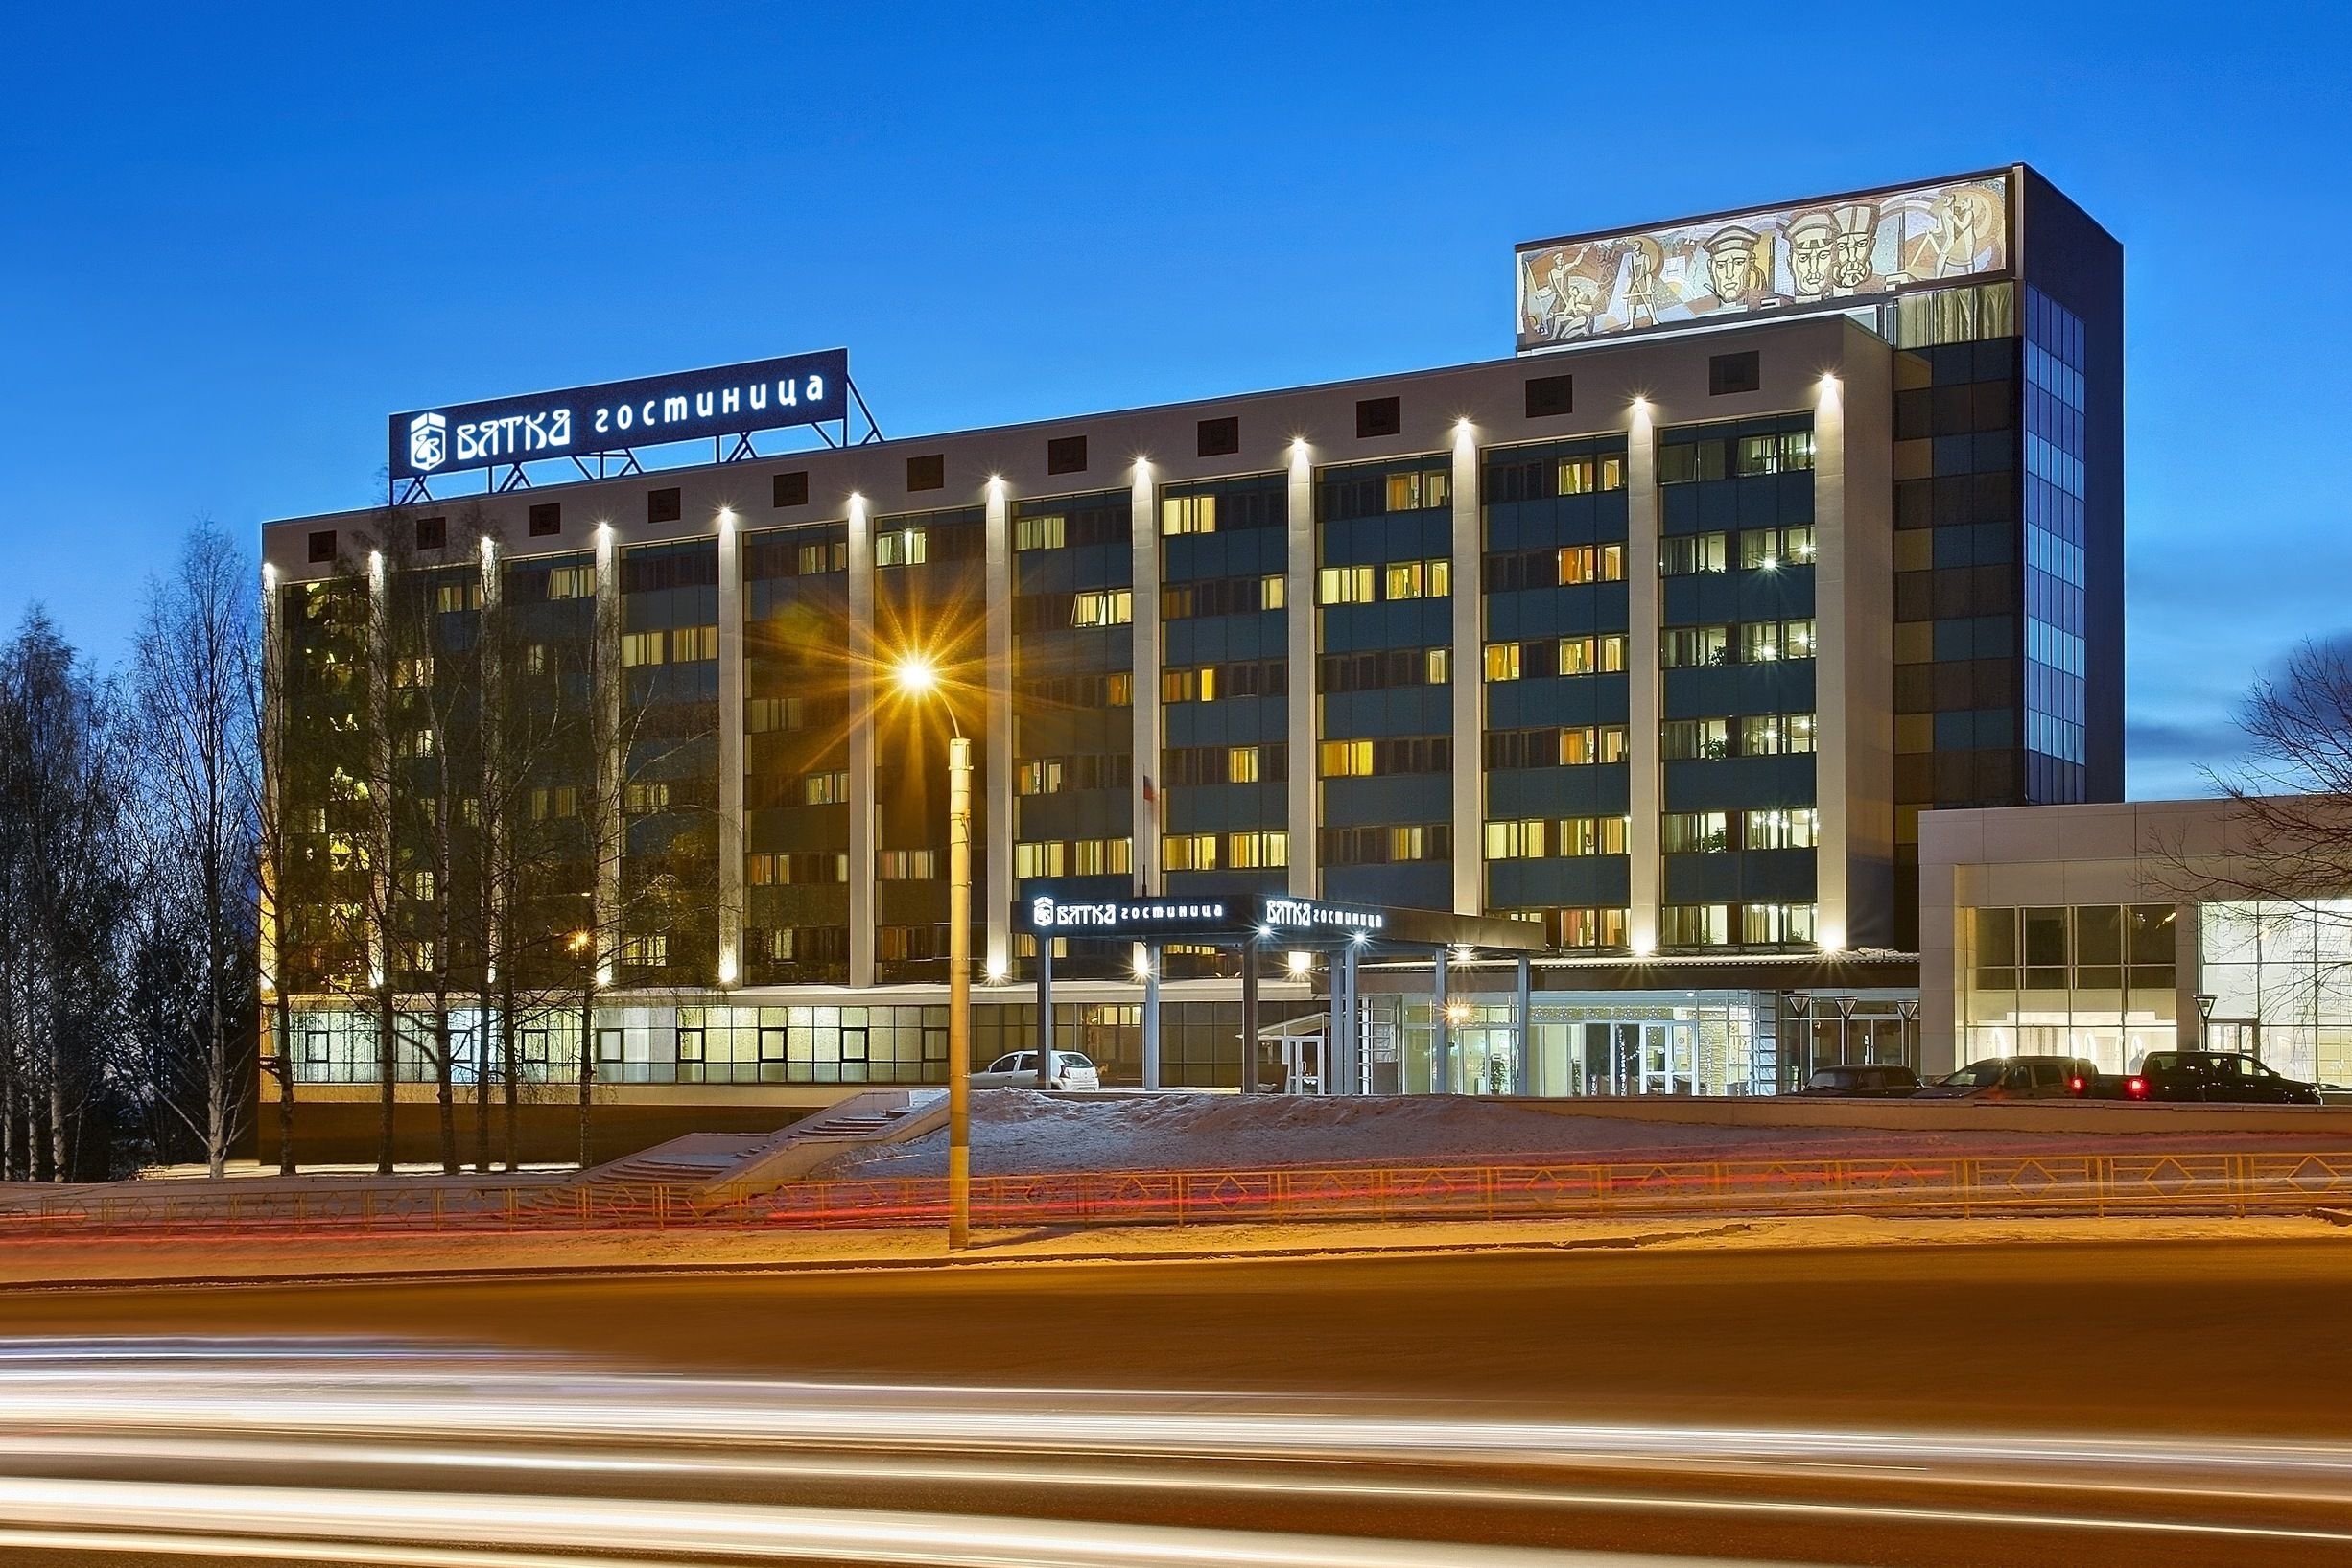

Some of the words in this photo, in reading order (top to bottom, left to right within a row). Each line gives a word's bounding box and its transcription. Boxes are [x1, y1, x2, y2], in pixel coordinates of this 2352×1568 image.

[456, 409, 571, 460] ВЯТКА
[595, 375, 823, 433] гостиница
[1056, 904, 1116, 925] ВЯТКА
[1120, 905, 1223, 920] гостиница
[1266, 900, 1311, 926] ВЯТКА
[1312, 908, 1382, 928] гостиница
